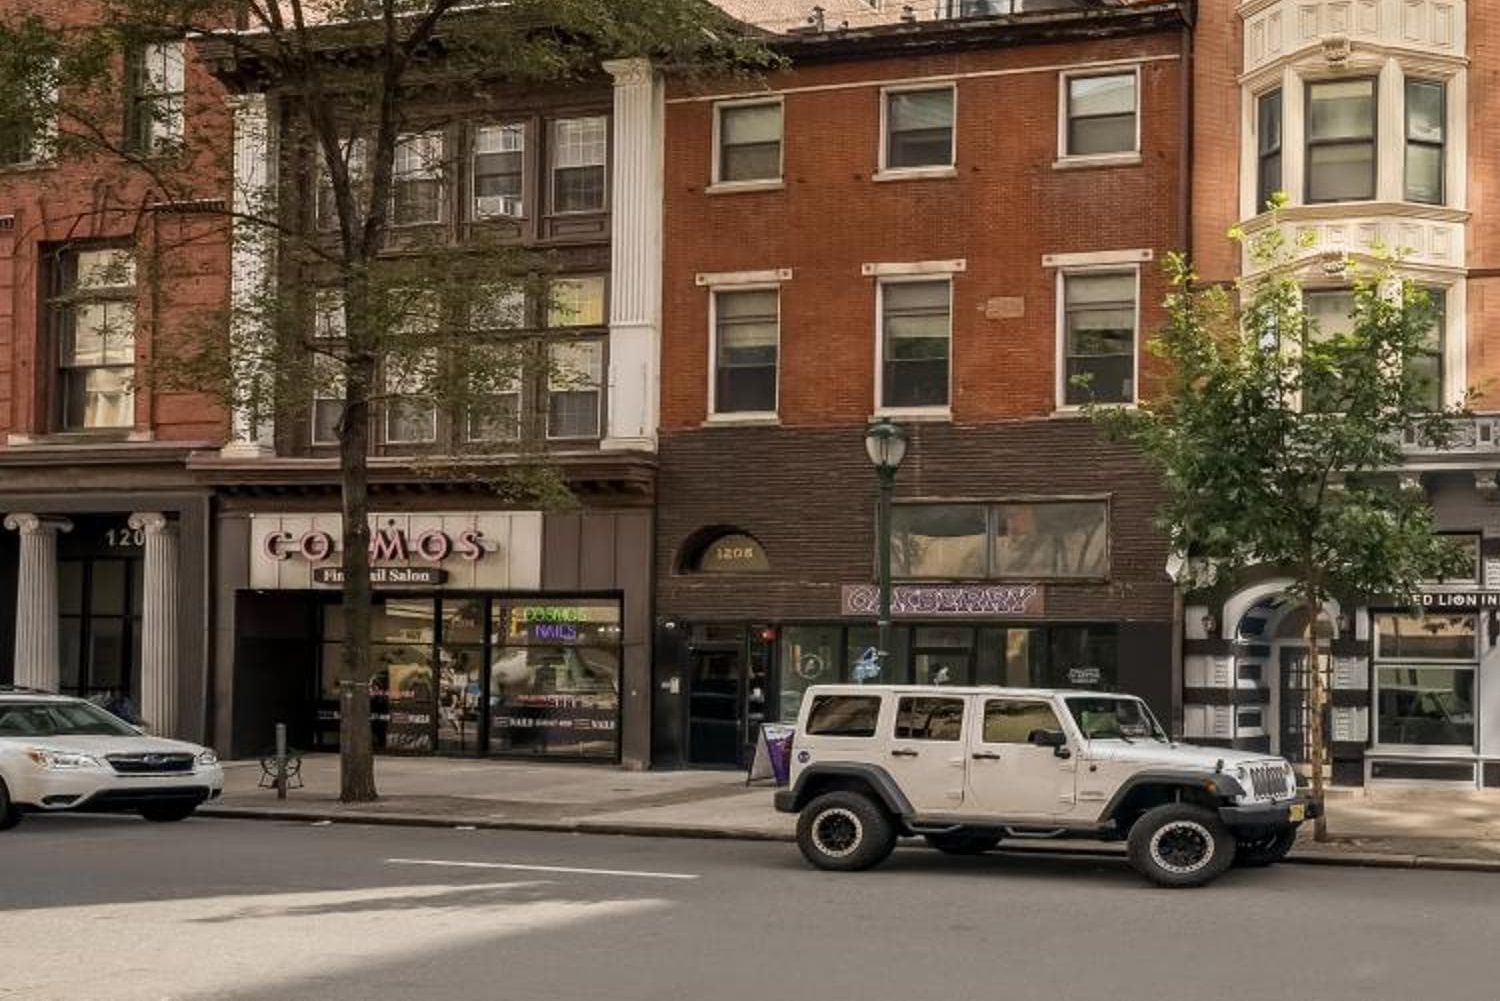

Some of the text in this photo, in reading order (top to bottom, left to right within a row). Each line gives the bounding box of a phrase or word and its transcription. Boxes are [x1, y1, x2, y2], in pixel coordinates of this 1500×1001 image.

[104, 529, 145, 546] 120
[264, 529, 487, 561] COMOS
[389, 568, 430, 582] Salon
[1403, 594, 1433, 606] ED
[1439, 594, 1477, 606] LION
